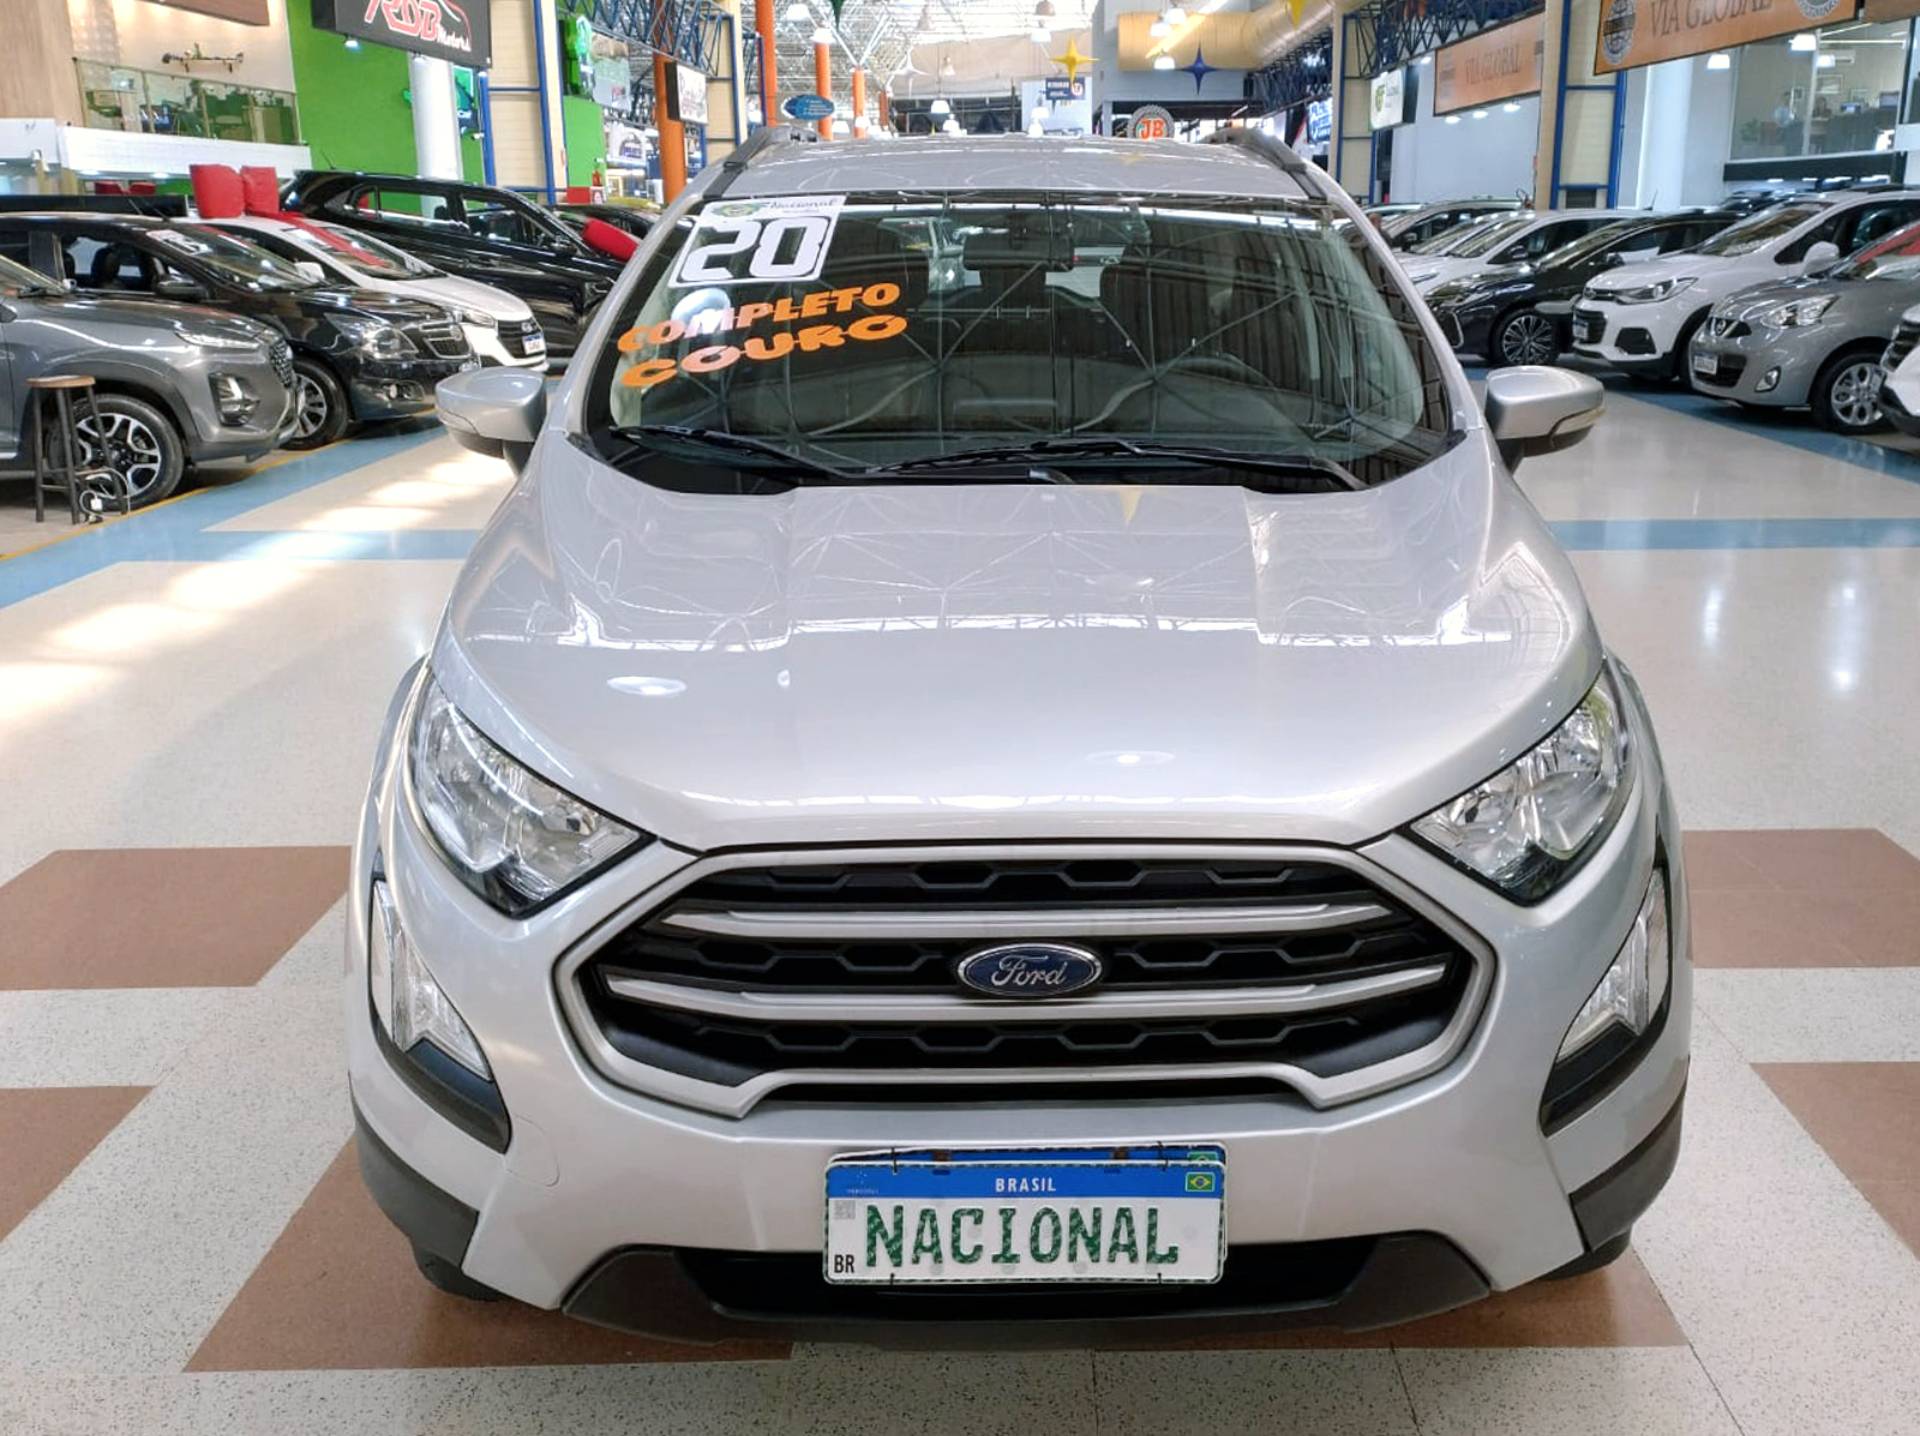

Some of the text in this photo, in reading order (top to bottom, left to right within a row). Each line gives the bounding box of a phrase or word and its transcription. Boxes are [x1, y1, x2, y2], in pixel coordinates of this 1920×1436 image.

[1650, 0, 1680, 37] VIA
[1685, 0, 1773, 29] GLOB
[1140, 118, 1165, 140] JB
[680, 215, 832, 283] 20
[617, 282, 900, 352] COMPLETO
[620, 314, 908, 388] COURO
[991, 954, 1069, 987] Ford
[995, 1177, 1057, 1193] BRASIL
[866, 1204, 1179, 1267] NACIONAL
[833, 1254, 855, 1273] BR
